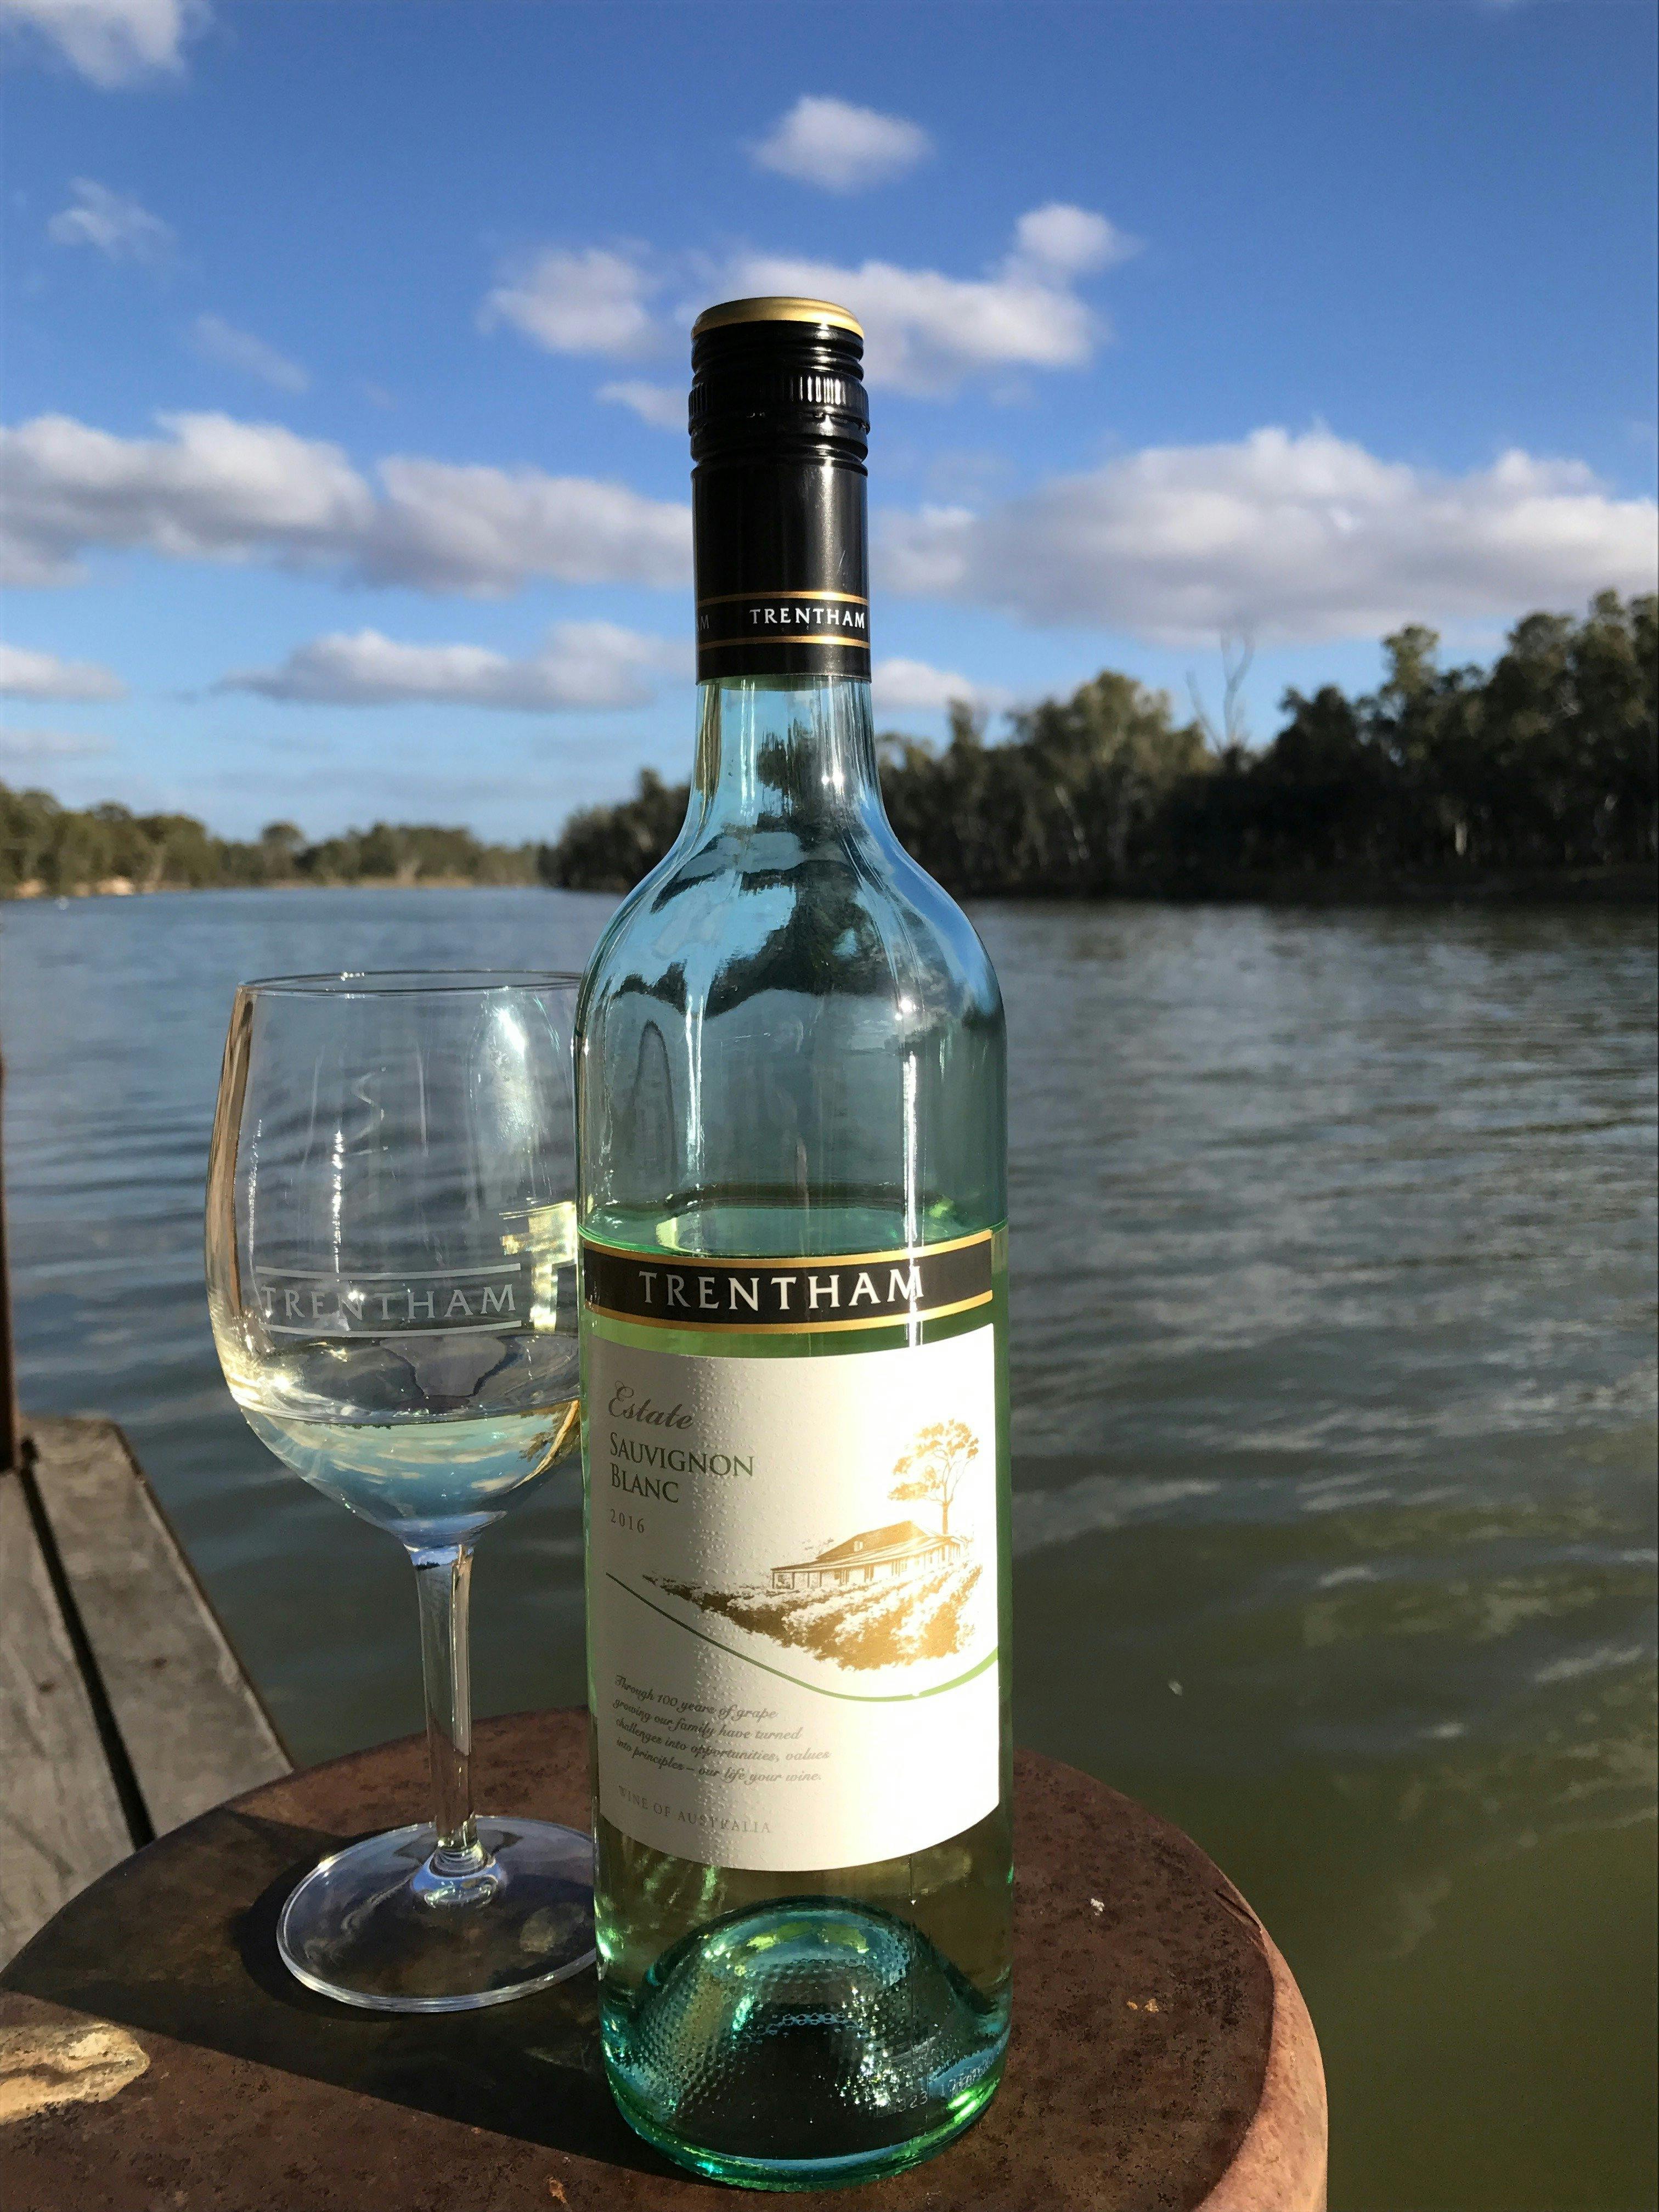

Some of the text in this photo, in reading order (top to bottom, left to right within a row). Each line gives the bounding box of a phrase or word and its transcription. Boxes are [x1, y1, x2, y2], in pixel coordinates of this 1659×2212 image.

[749, 607, 865, 629] TRENTHAM
[261, 1283, 516, 1321] TRENTHAM
[639, 1265, 924, 1311] TRENTHAM
[608, 1380, 693, 1429] Estate
[610, 1431, 754, 1477] SAUVIGNON
[610, 1462, 679, 1503] BLANC
[610, 1508, 645, 1534] 2016
[614, 1674, 778, 1723] Through 100 years of grape
[613, 1699, 804, 1740] growing our family have turned
[664, 1737, 687, 1751] into
[786, 1747, 832, 1761] values
[744, 1773, 782, 1785] your
[653, 1803, 671, 1817] OF
